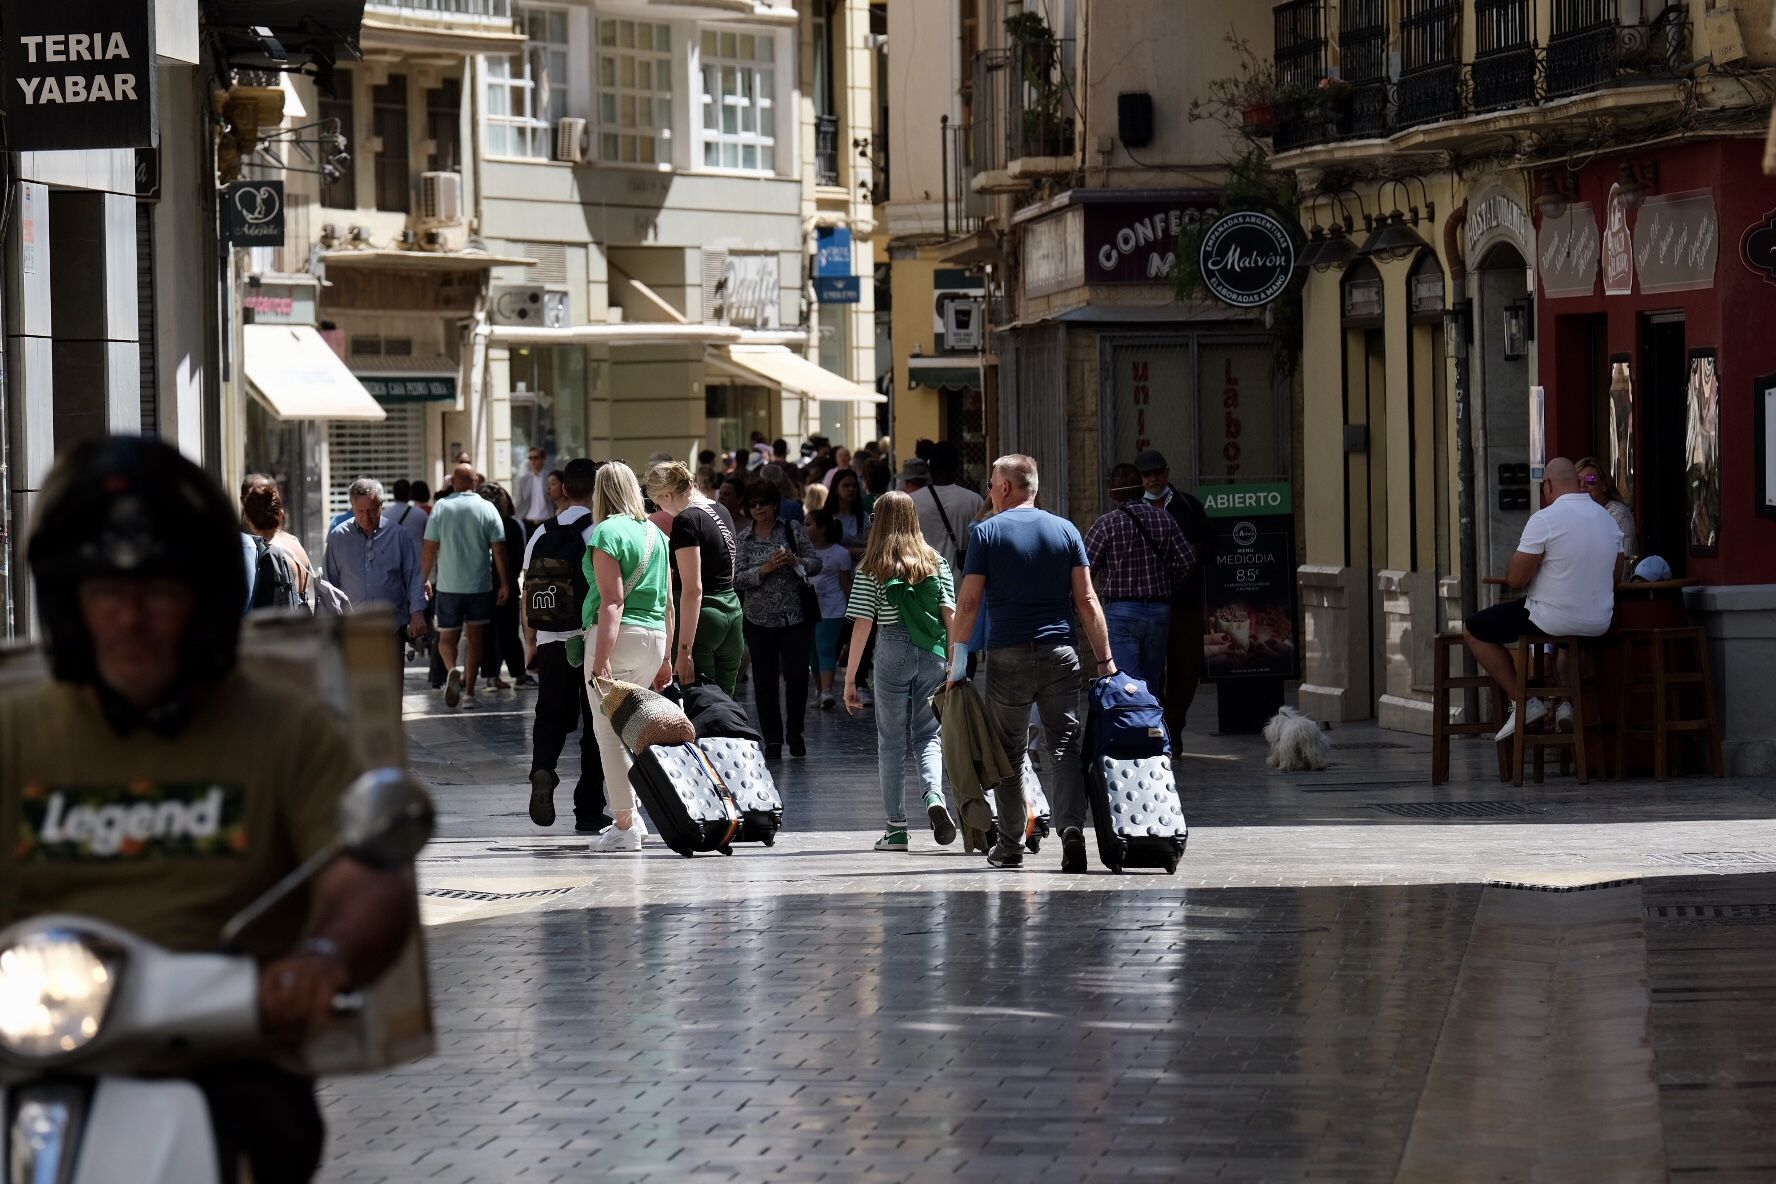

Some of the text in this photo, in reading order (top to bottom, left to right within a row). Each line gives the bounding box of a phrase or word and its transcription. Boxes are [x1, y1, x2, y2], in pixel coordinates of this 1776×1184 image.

[20, 31, 131, 63] TERIA
[16, 73, 138, 105] YABAR
[1205, 215, 1289, 252] EMPANADAS ARGENTINAS
[1468, 198, 1498, 250] HOSTAL
[1207, 243, 1287, 273] Malvón
[1209, 276, 1260, 303] ELABORADAS
[1266, 274, 1286, 297] MANO
[1204, 492, 1281, 509] ABIERTO
[40, 783, 225, 857] Legend
